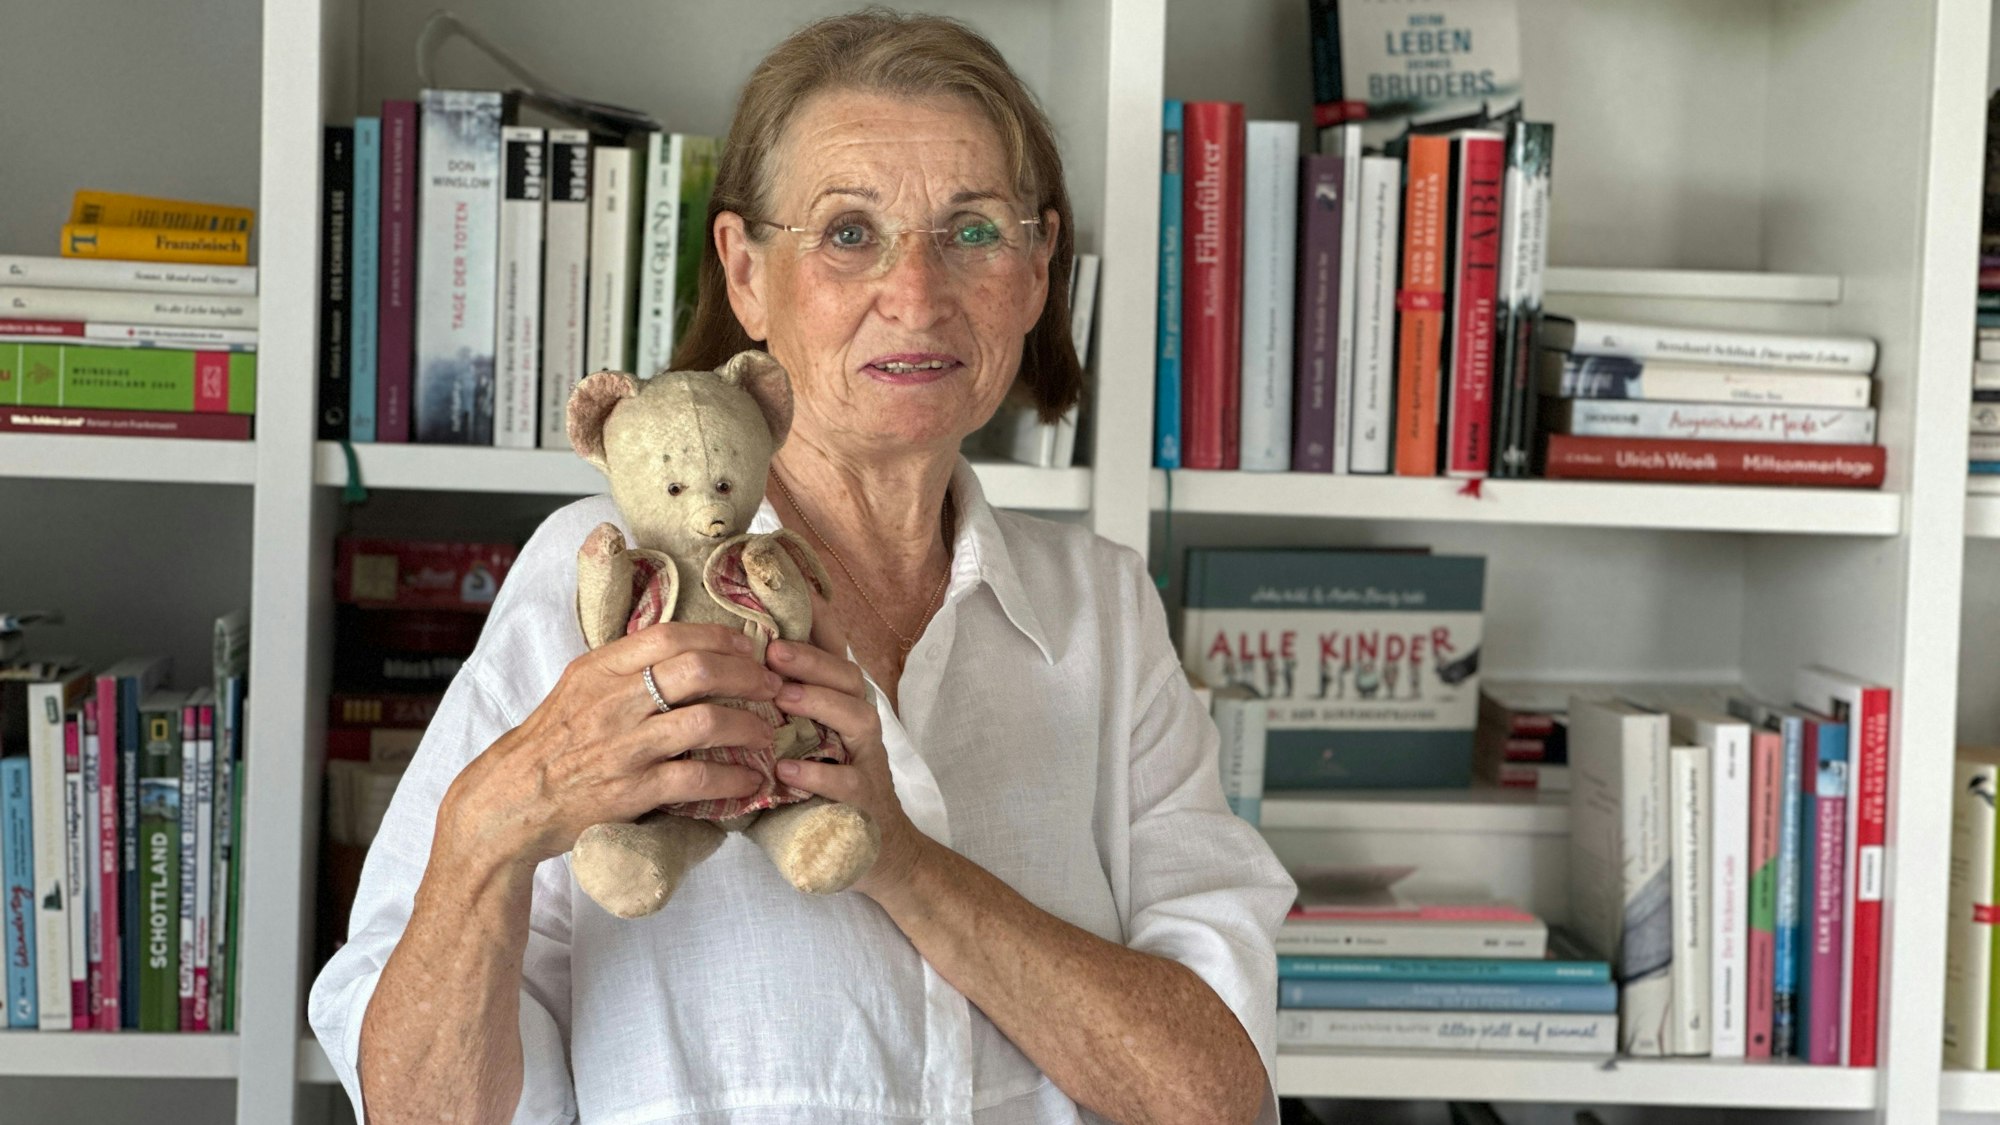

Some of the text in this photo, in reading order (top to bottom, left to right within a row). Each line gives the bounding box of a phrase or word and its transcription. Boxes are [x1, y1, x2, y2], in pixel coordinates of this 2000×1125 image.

[1385, 30, 1472, 56] LEBEN
[1368, 70, 1497, 98] BRUDERS
[432, 175, 491, 188] WINSLOW
[447, 159, 476, 172] DON
[524, 144, 541, 199] PIPER
[570, 147, 587, 200] PIPER
[1194, 139, 1220, 264] Filmführer
[155, 234, 242, 253] Französisch
[452, 201, 468, 330] TAGE DER TOTEN
[1411, 251, 1422, 285] VON
[1423, 251, 1435, 285] UND
[1473, 298, 1490, 401] SCHIRACH
[71, 378, 147, 388] DEUTSCHLAND
[1615, 450, 1666, 469] Ulrich
[1666, 452, 1718, 470] Woelk
[1742, 454, 1875, 480] Mittsommertage
[1207, 626, 1455, 671] ALLE KINDER
[67, 781, 81, 840] Helgoland
[102, 784, 114, 815] DINGE
[102, 852, 114, 874] WDR
[124, 846, 136, 871] WDR
[1817, 801, 1833, 955] ELKE HEIDENREICH
[149, 832, 168, 969] SCHOTTLAND
